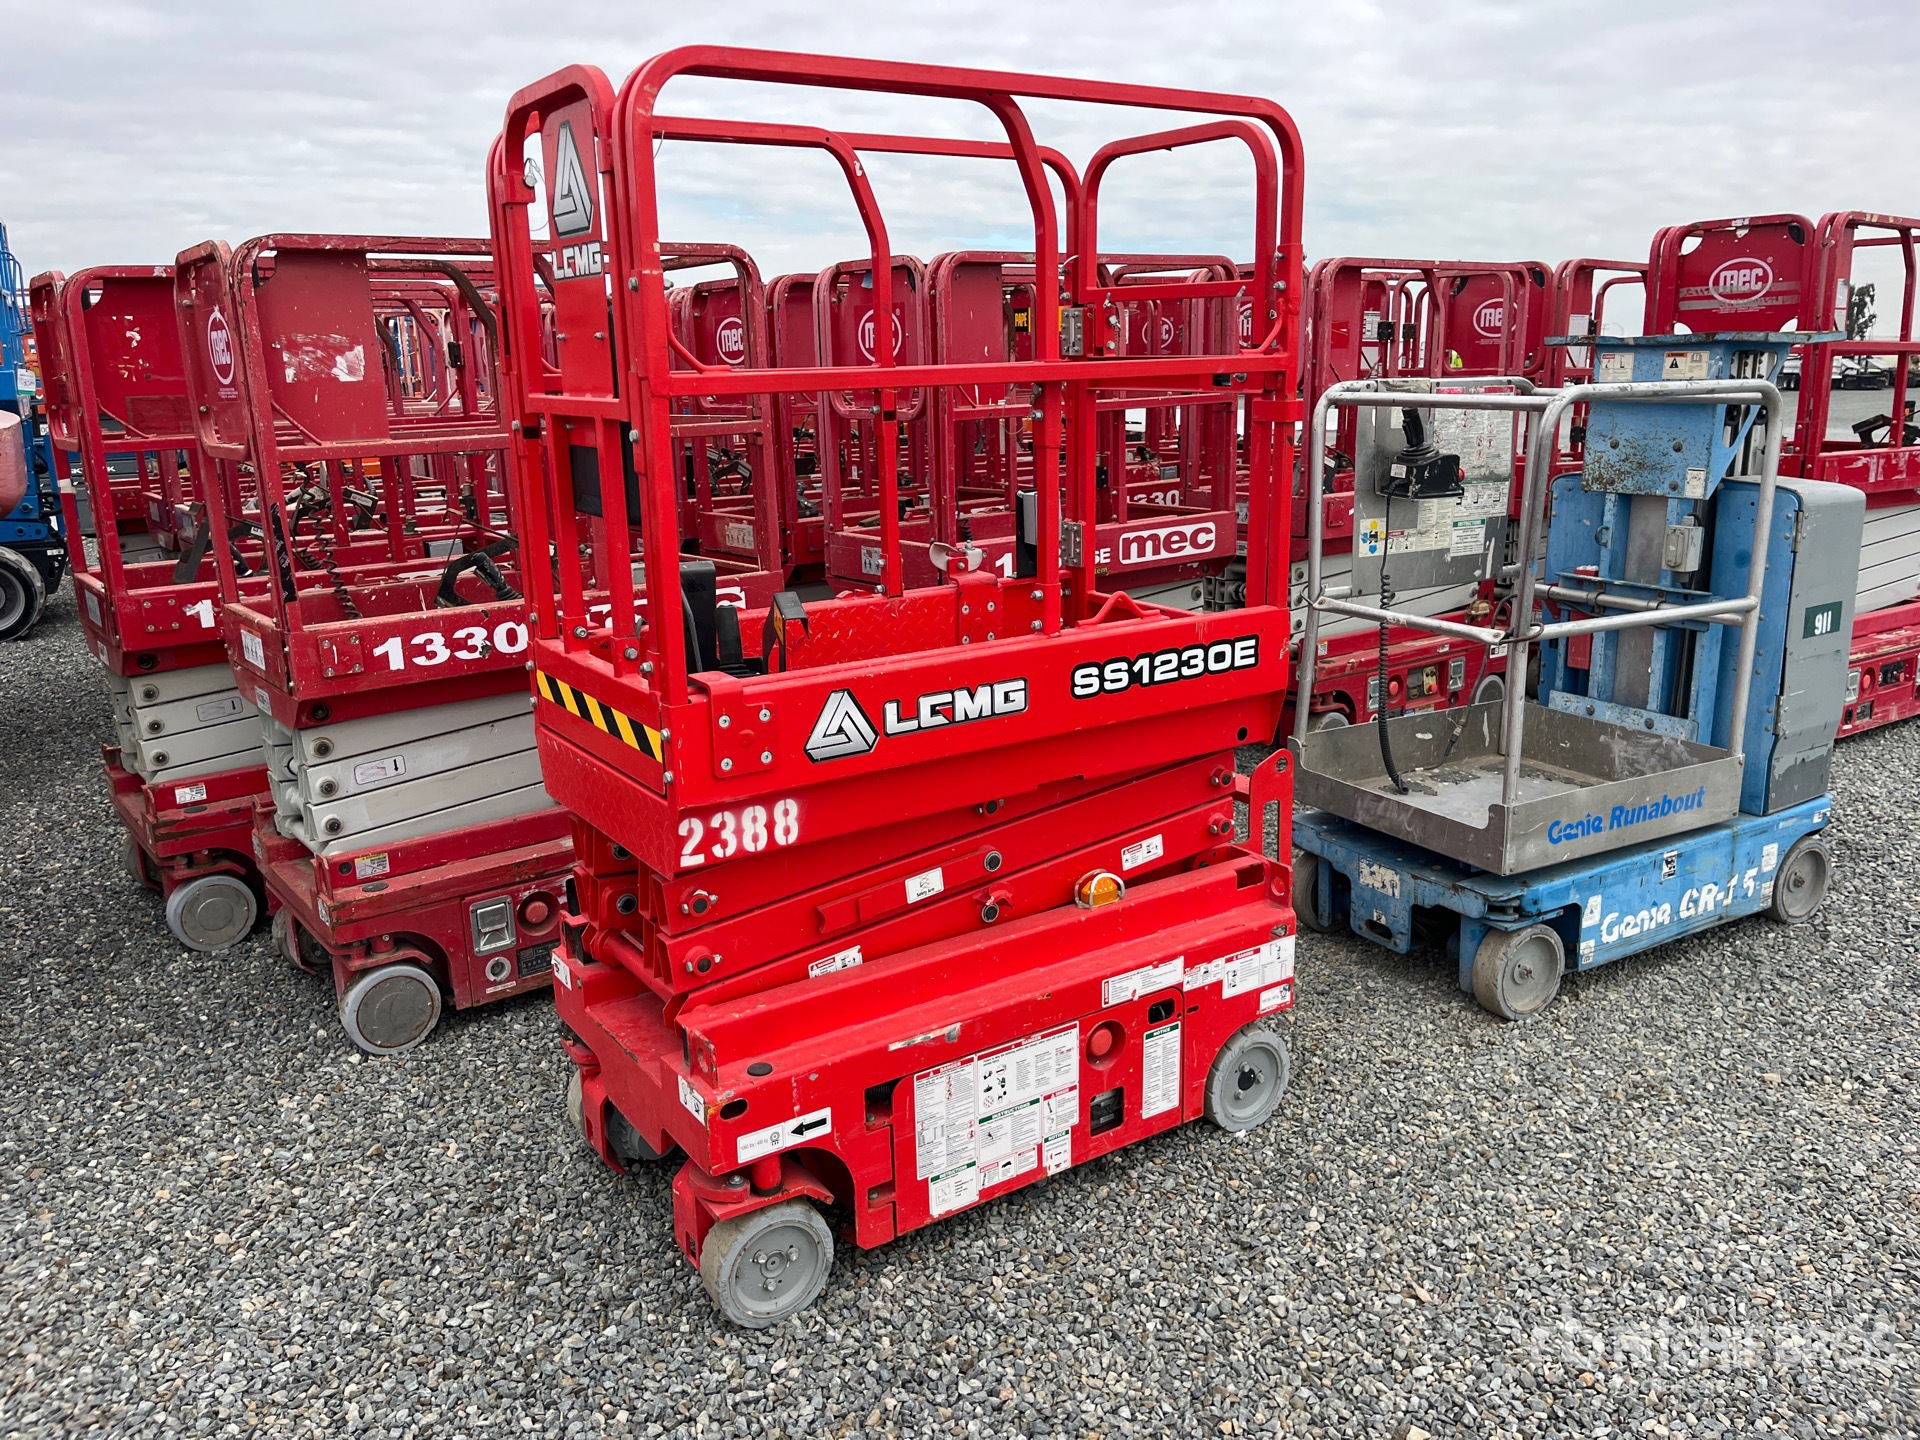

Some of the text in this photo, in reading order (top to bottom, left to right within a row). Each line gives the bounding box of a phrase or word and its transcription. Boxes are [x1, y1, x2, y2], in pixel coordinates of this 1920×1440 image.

[1718, 267, 1764, 293] mec
[1121, 526, 1215, 561] mec
[373, 621, 529, 671] 1330
[1814, 610, 1832, 635] 911
[1073, 638, 1257, 696] SS1230E
[678, 798, 799, 868] 2388
[1547, 785, 1706, 845] Genie Runabout
